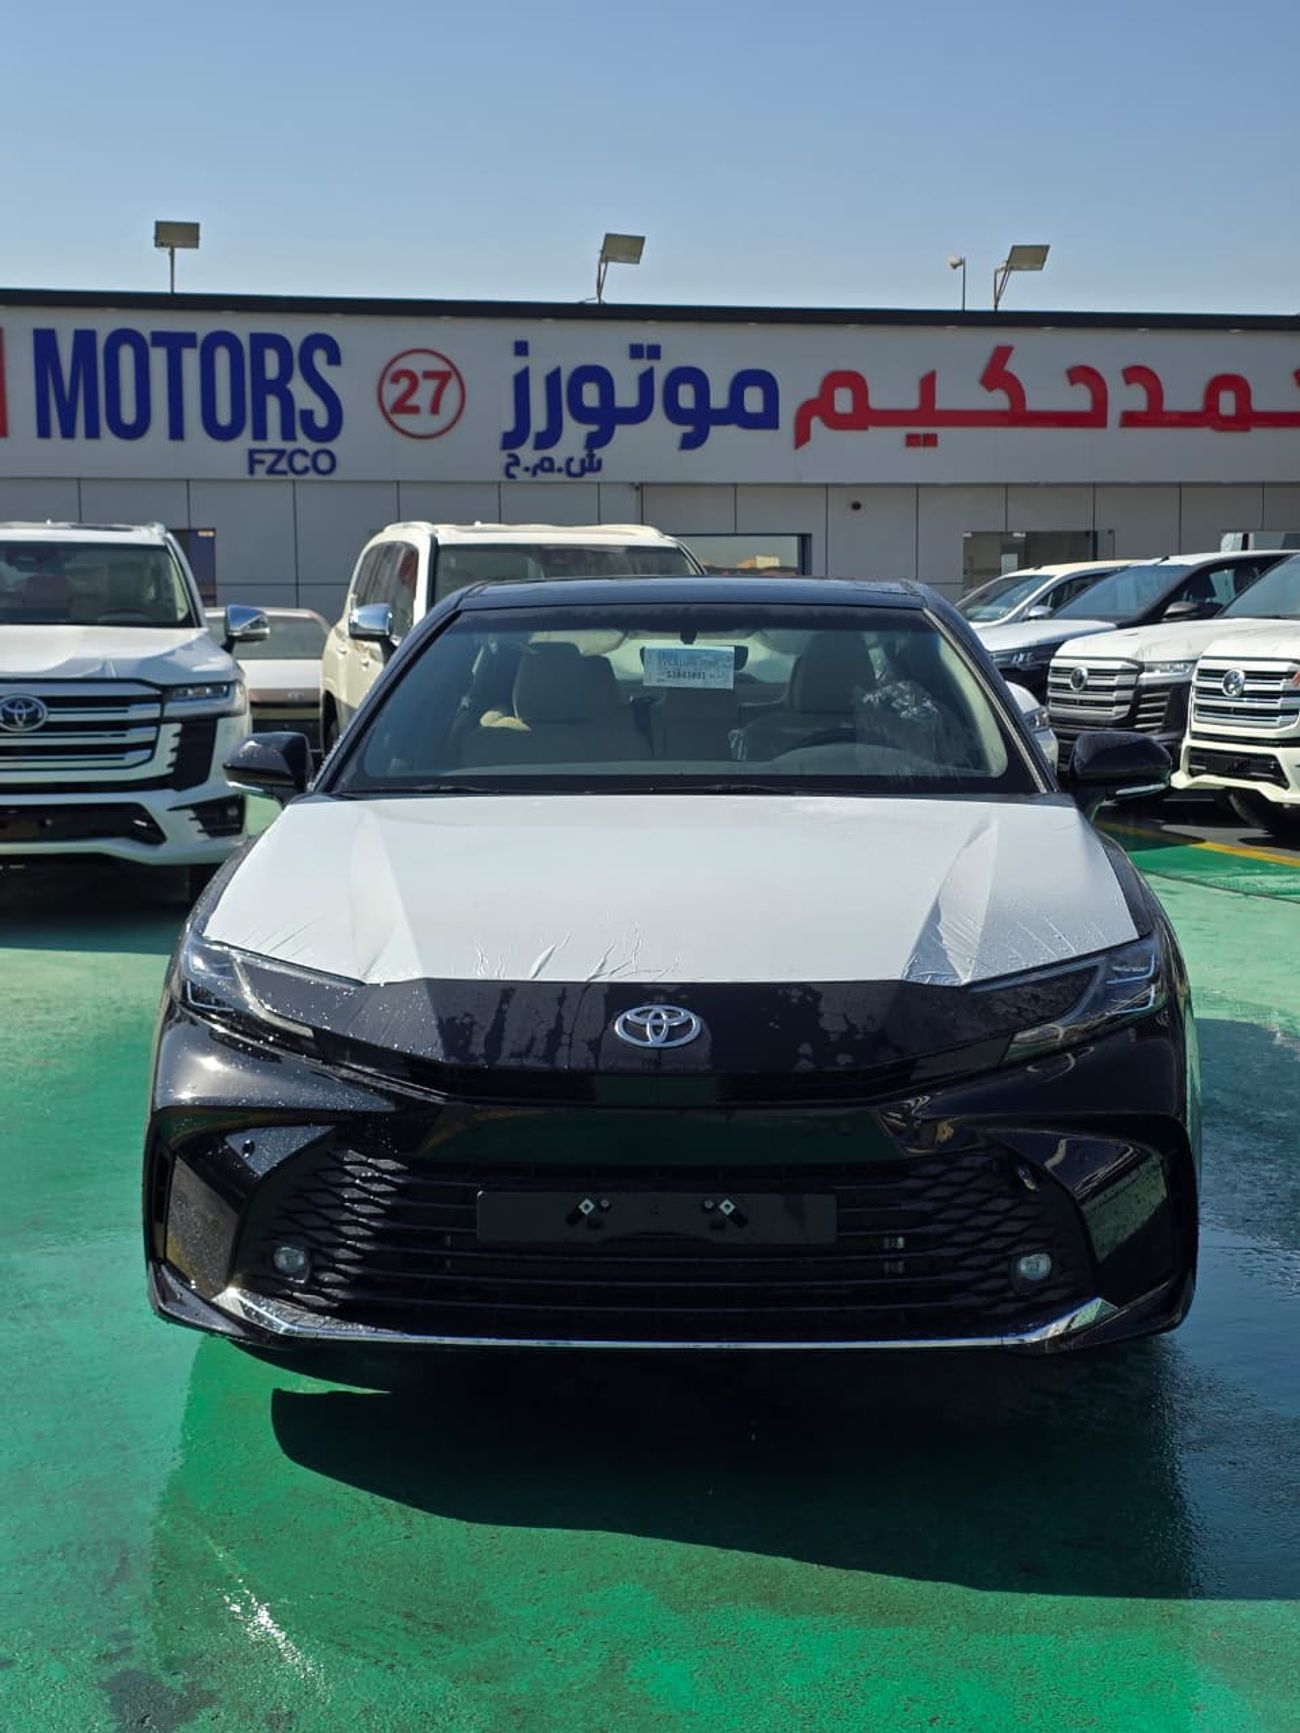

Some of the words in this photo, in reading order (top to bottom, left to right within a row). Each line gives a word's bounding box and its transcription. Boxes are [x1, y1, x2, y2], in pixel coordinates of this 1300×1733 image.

[33, 328, 343, 443] MOTORS
[389, 369, 452, 415] 27
[500, 339, 780, 451] موتورز
[794, 345, 1107, 450] حكيم
[1119, 364, 1300, 432] مد
[247, 448, 337, 475] FZCO
